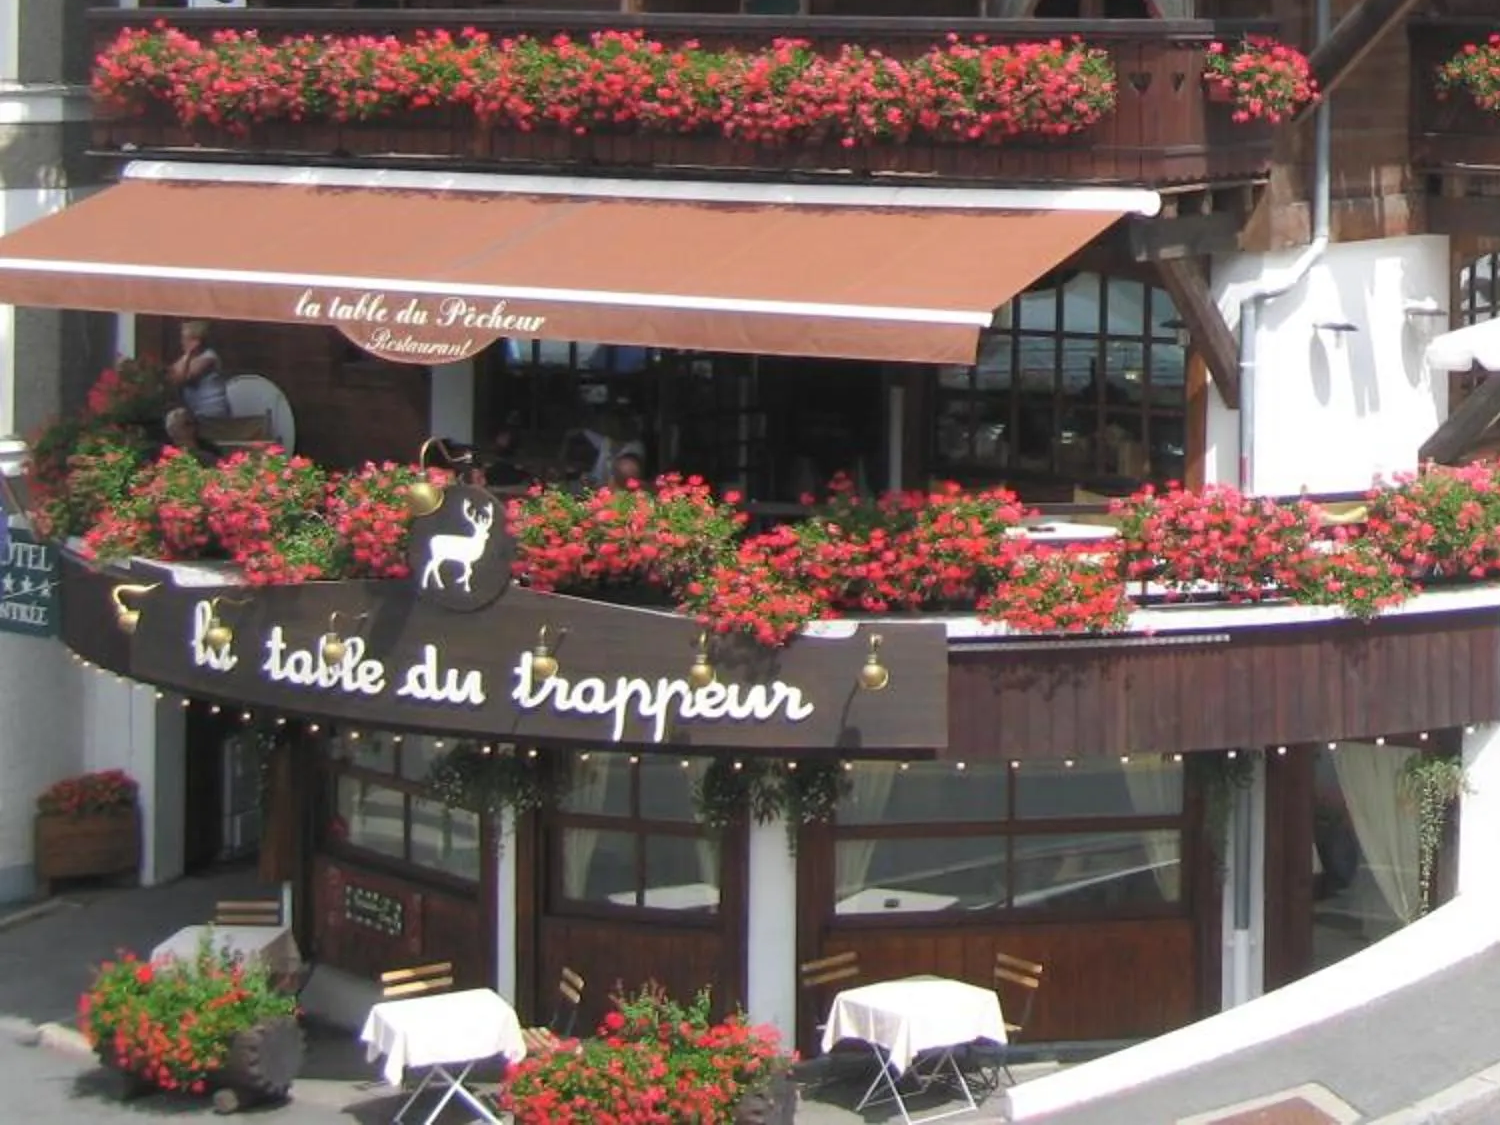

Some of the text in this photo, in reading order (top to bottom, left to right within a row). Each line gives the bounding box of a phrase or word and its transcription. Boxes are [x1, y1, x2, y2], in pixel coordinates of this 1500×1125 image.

[294, 287, 546, 332] la table du Pêcheur
[365, 327, 473, 355] Restaurant
[262, 626, 385, 694] table
[397, 644, 486, 704] du
[512, 651, 814, 742] trappeur
